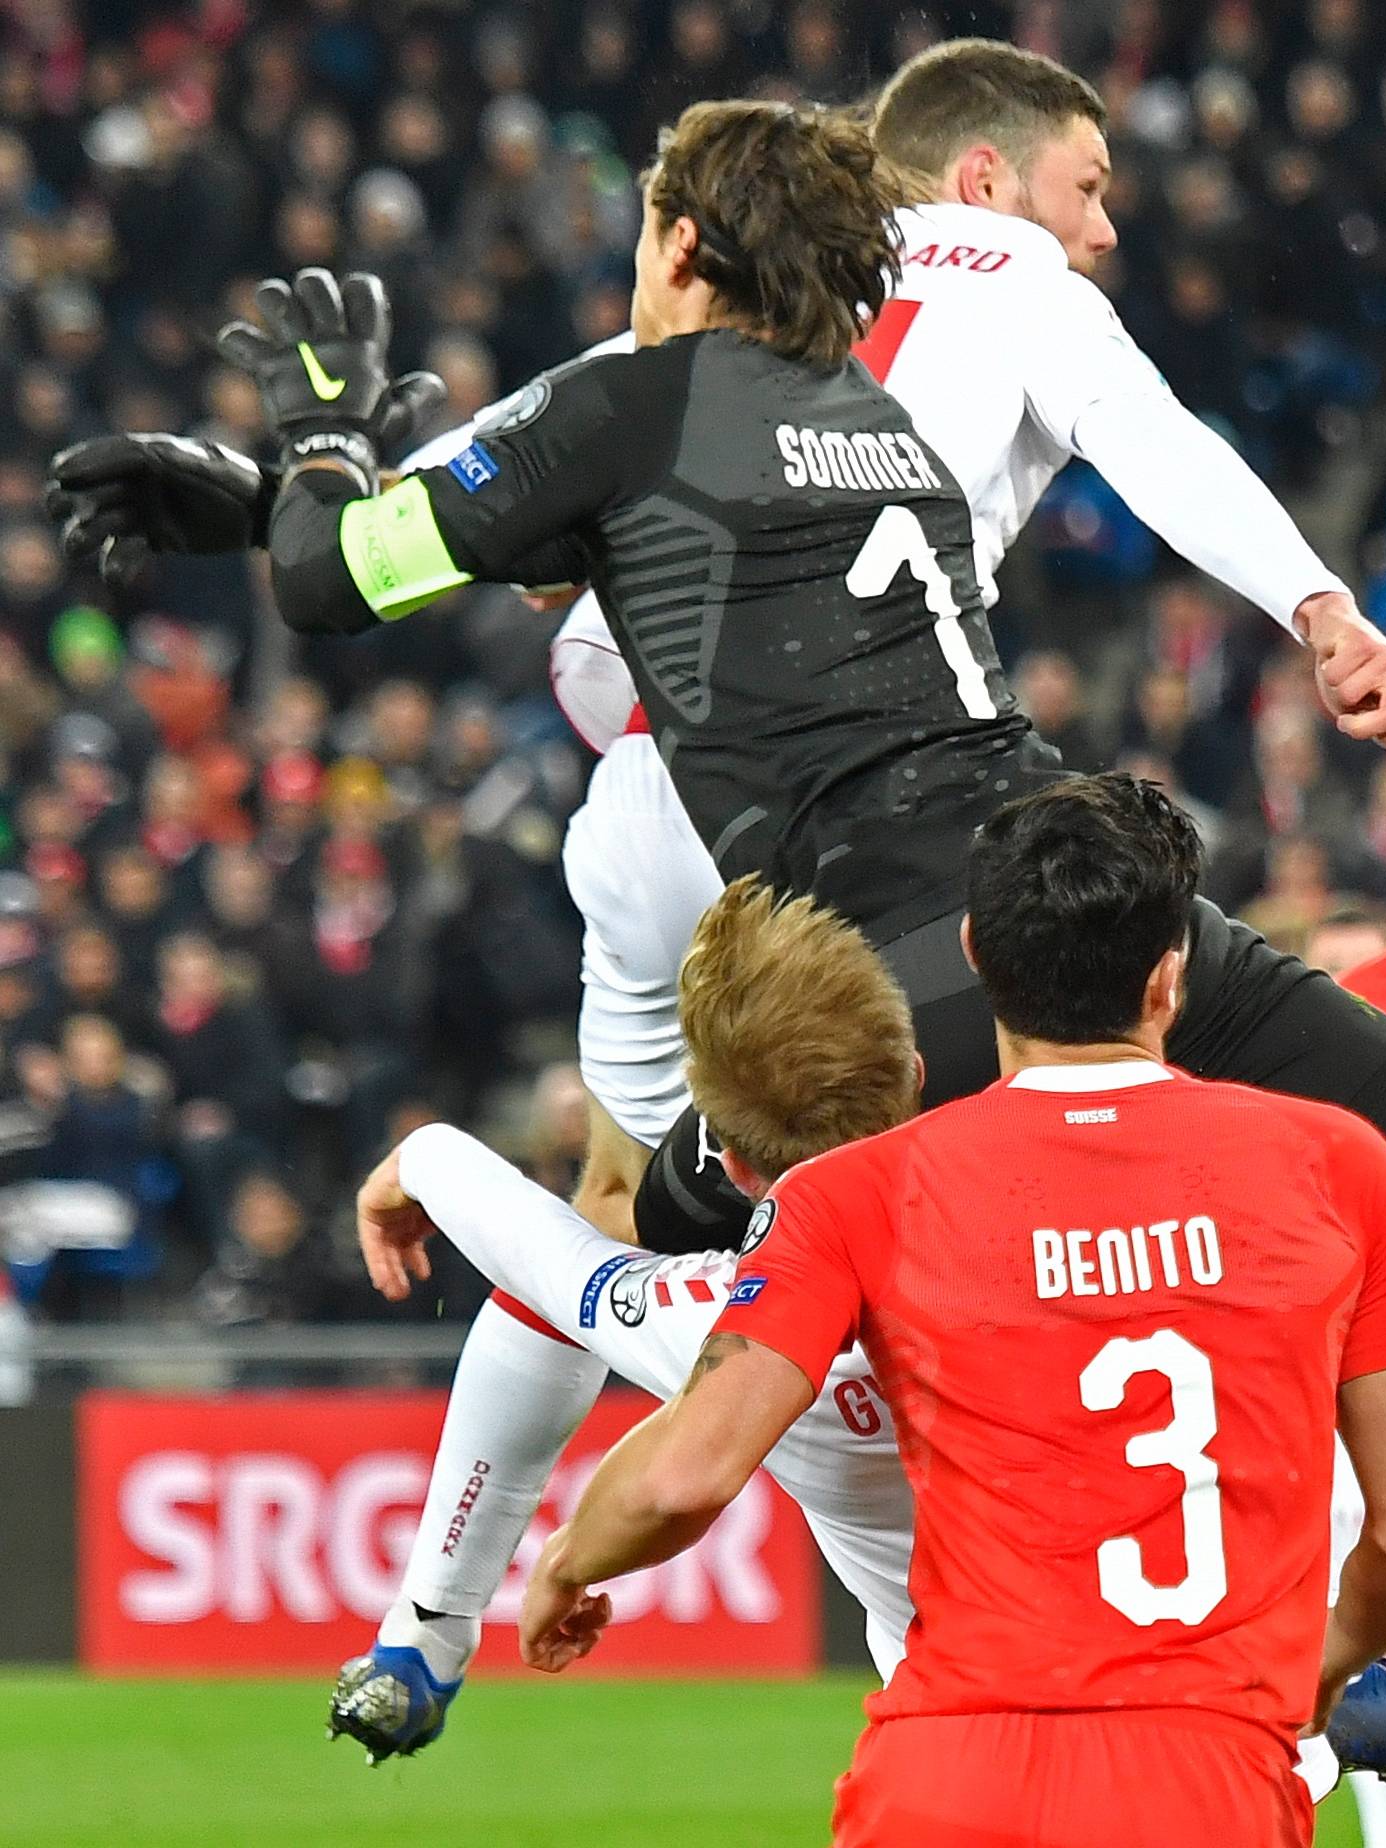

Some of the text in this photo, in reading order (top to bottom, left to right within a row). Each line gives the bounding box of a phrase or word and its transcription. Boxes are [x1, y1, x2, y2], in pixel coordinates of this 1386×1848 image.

[775, 424, 942, 490] SOMMER
[845, 504, 998, 720] 1
[1064, 1107, 1120, 1124] SUISSE
[582, 1257, 626, 1328] RESPECT
[1032, 1215, 1224, 1299] BENITO
[1078, 1328, 1228, 1627] 3
